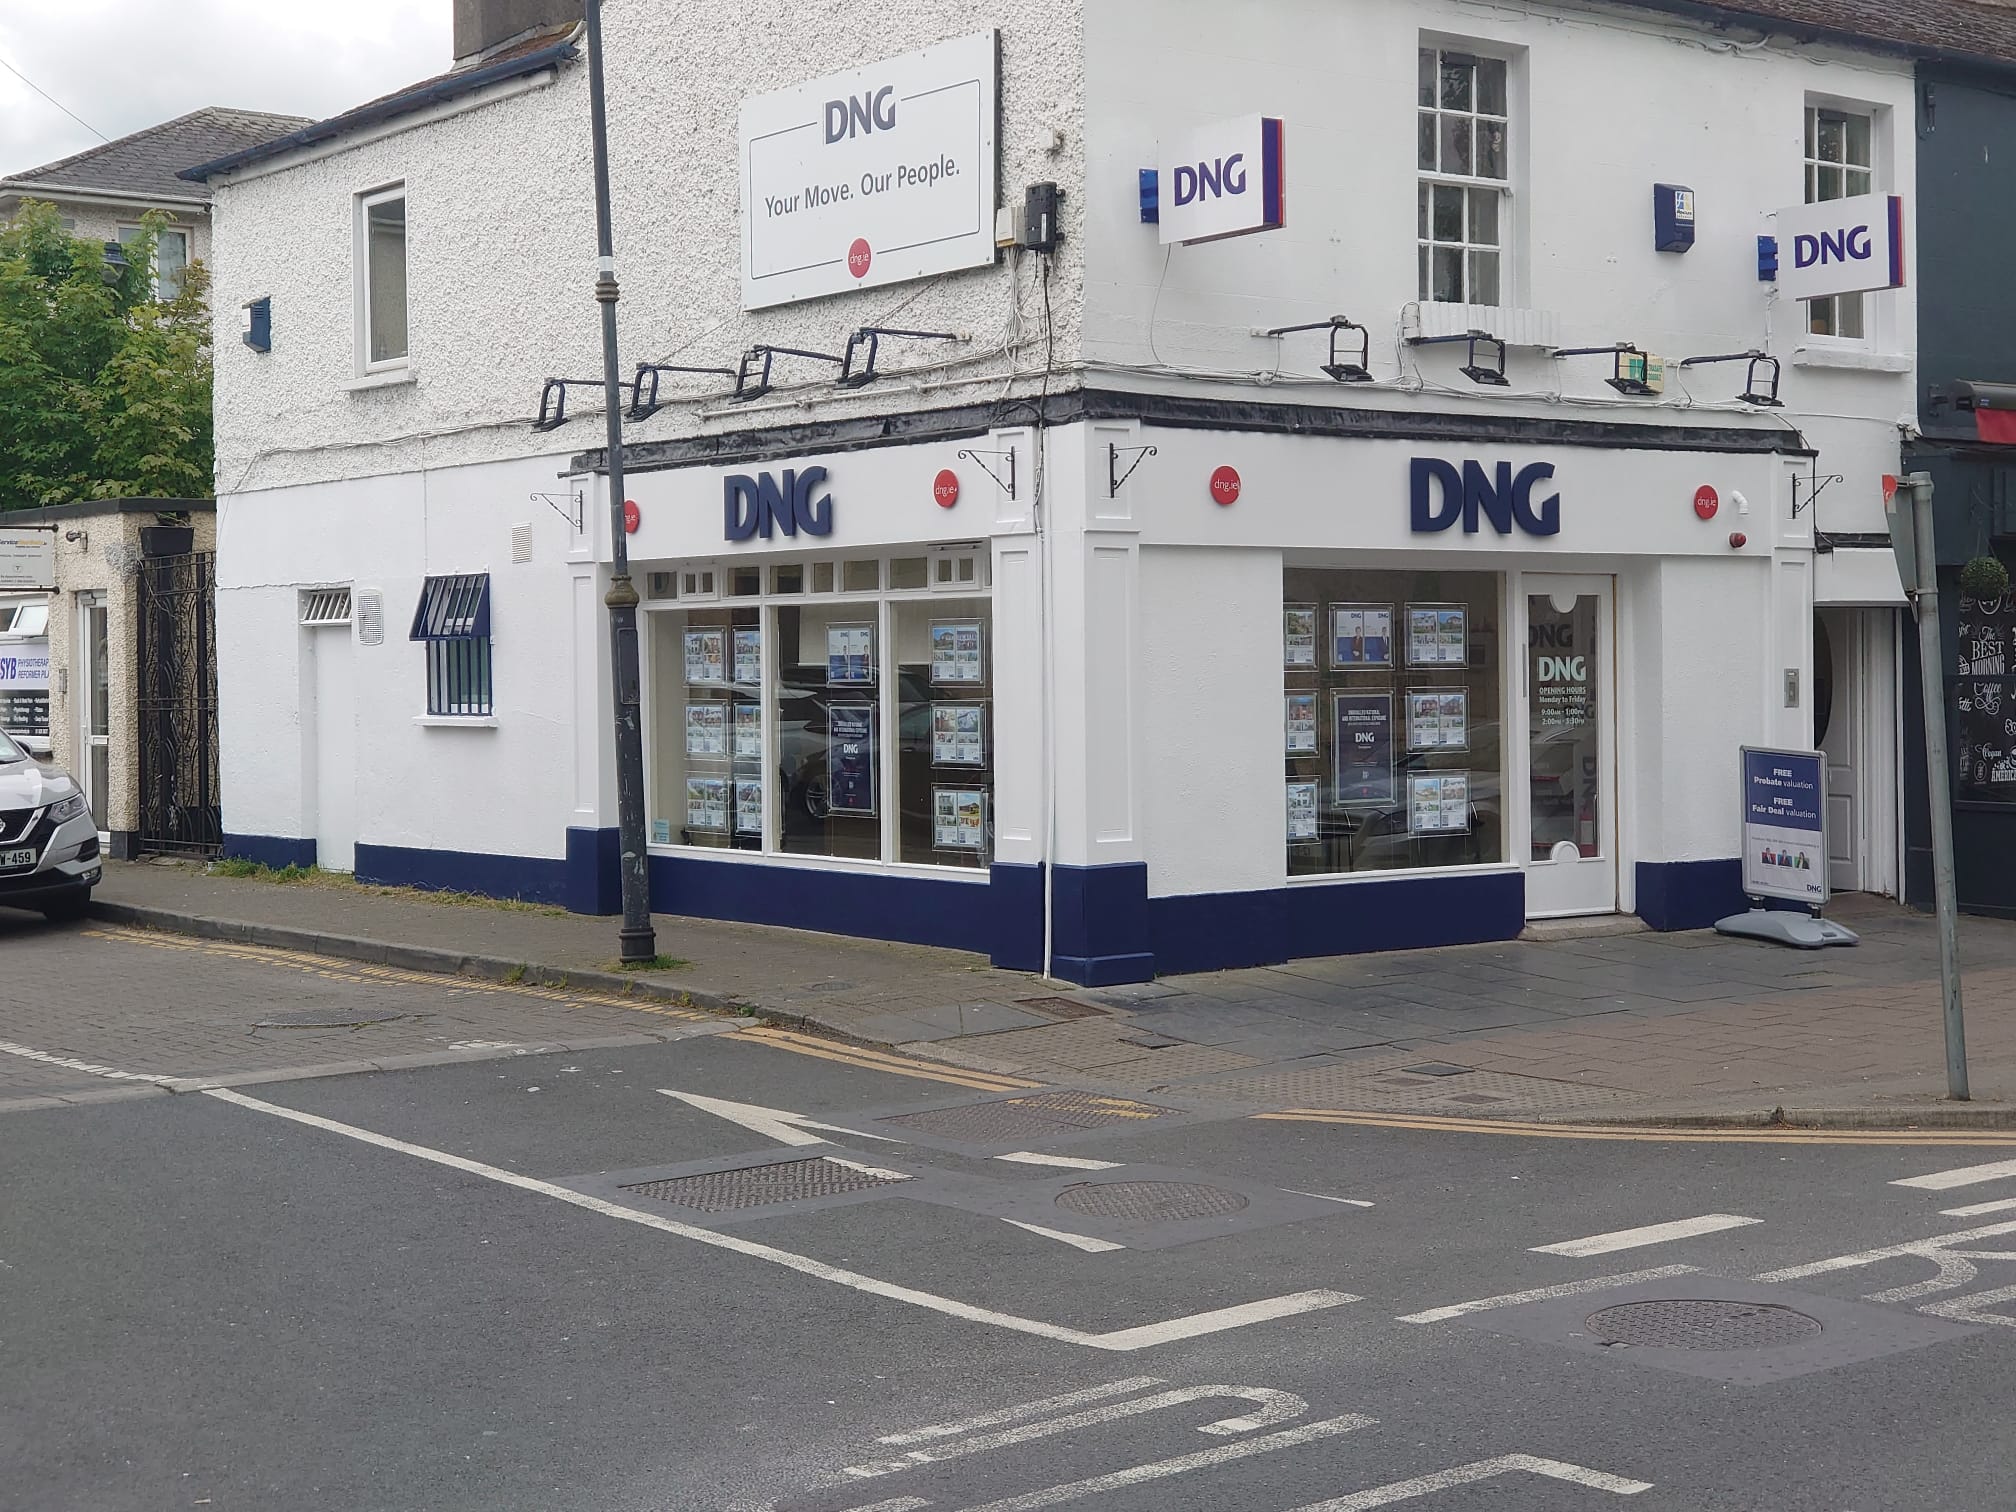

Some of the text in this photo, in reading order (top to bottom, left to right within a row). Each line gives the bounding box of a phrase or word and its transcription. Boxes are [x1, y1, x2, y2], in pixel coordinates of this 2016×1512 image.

[825, 85, 896, 145] DNG
[764, 153, 960, 218] Your Move. Our People.
[1173, 153, 1247, 207] DNG
[1794, 225, 1872, 269] DNG
[849, 252, 870, 266] dng.ie
[1214, 477, 1238, 493] dng.ie
[723, 465, 833, 541] DNG
[1409, 456, 1561, 536] DNG
[1971, 641, 2005, 661] BEST
[1538, 656, 1586, 681] DNG
[1971, 654, 2006, 675] MORNING
[1539, 686, 1586, 695] OPENING HOURS
[1539, 696, 1561, 704] Monday
[1569, 695, 1586, 704] Friday
[1355, 732, 1375, 743] DNG
[843, 743, 859, 754] DNG
[1773, 768, 1792, 777] FREE
[1753, 776, 1814, 790] Probate valuation
[1773, 797, 1793, 806] FREE
[1752, 804, 1817, 819] Fair Deal valuation
[1806, 884, 1822, 893] DNG
